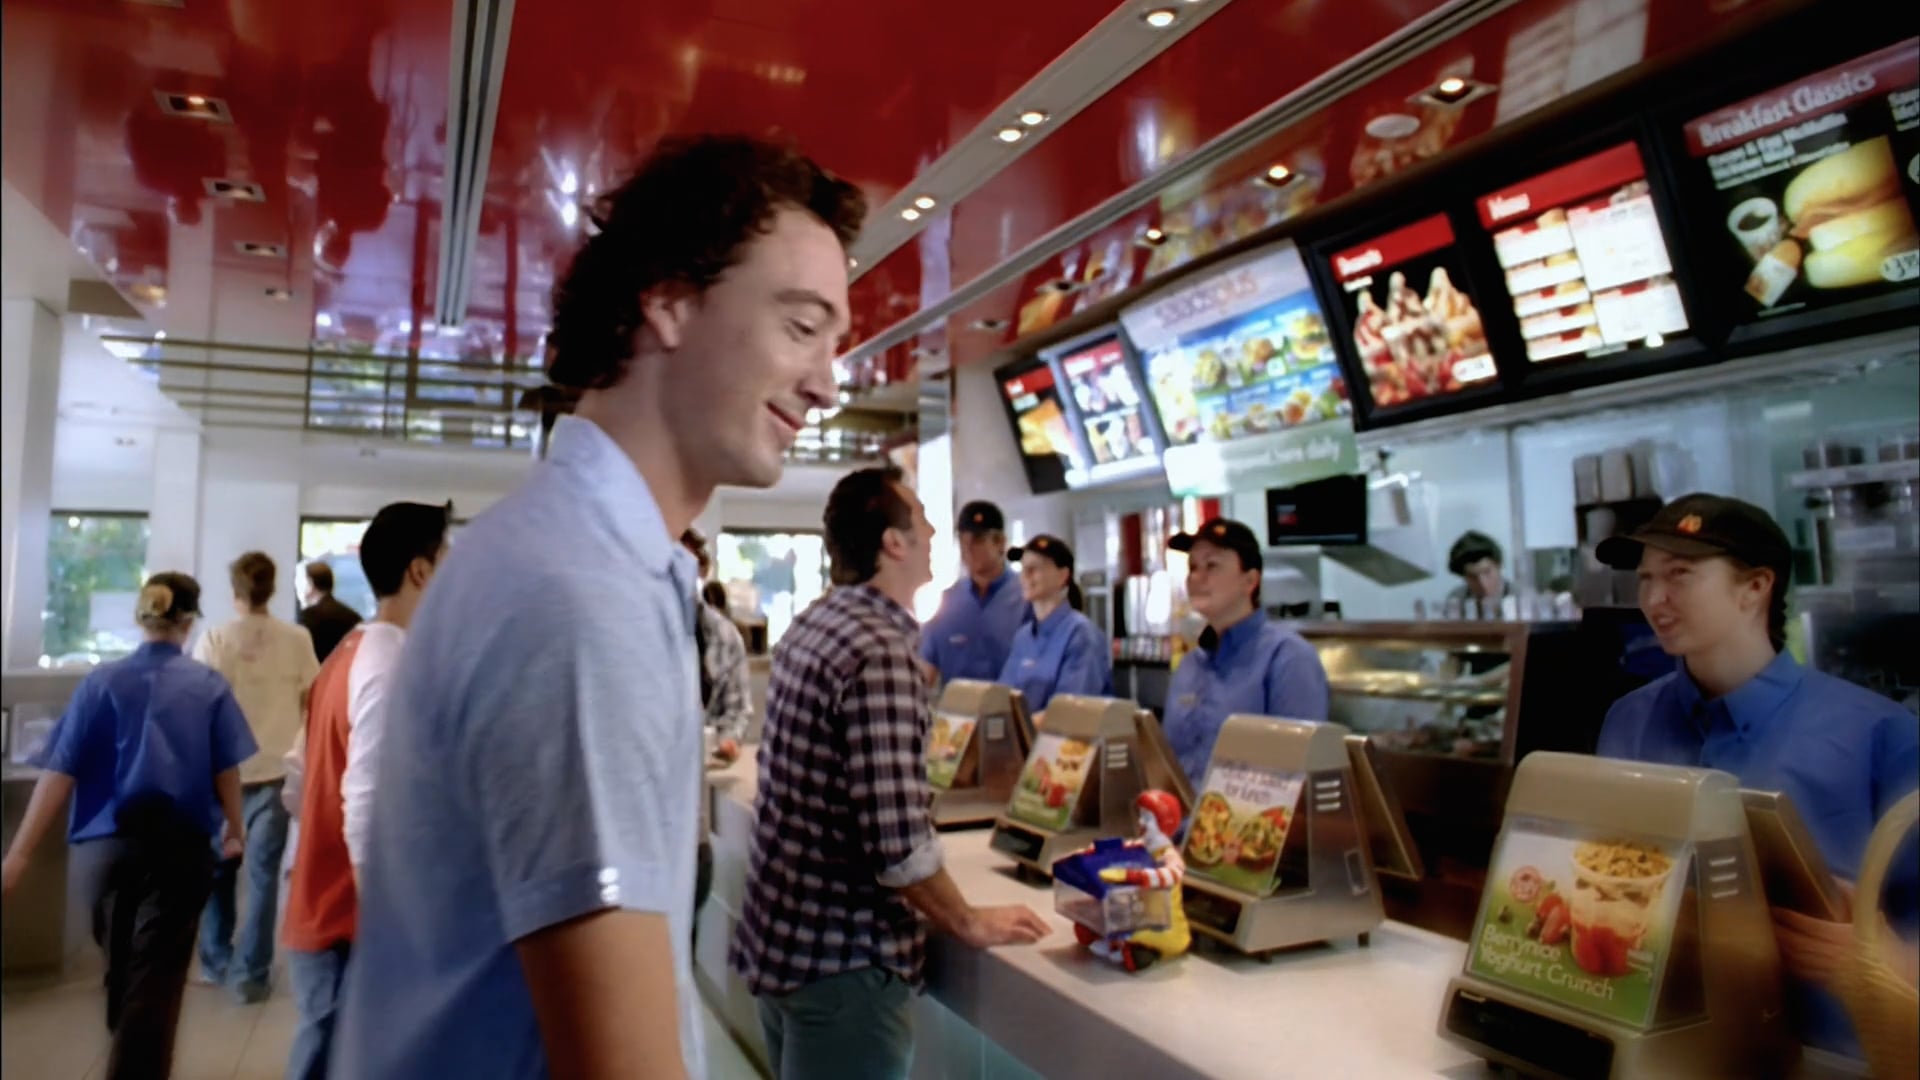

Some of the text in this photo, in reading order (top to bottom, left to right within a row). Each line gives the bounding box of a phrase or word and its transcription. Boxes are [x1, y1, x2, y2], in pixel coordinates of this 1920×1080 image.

[1699, 99, 1793, 147] Breakfast
[1792, 71, 1876, 114] Classics
[1480, 943, 1543, 979] Yoghurt
[1547, 962, 1614, 1000] Crunch
